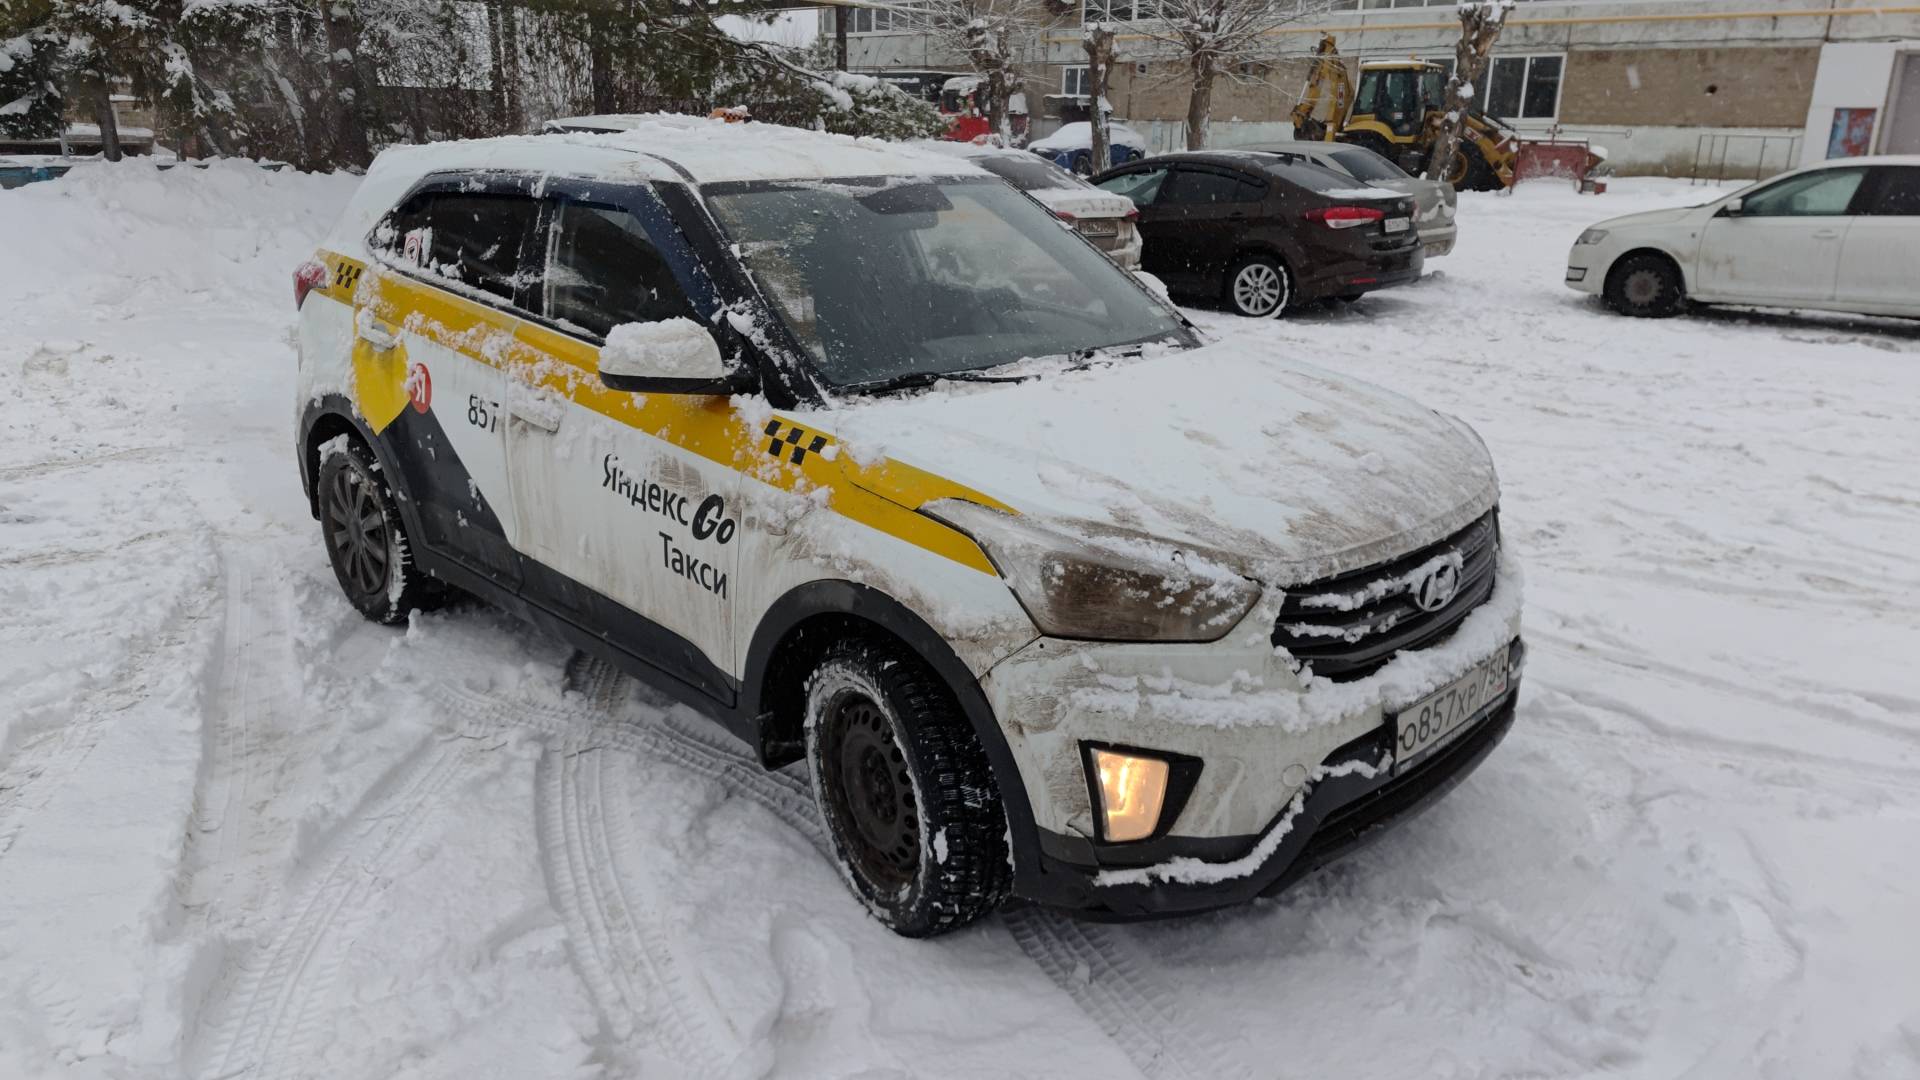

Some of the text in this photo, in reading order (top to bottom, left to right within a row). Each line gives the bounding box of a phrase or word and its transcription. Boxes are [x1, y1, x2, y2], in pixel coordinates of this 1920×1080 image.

[468, 393, 499, 433] 857
[602, 453, 736, 545] Яндекс Go
[658, 531, 728, 600] Такси
